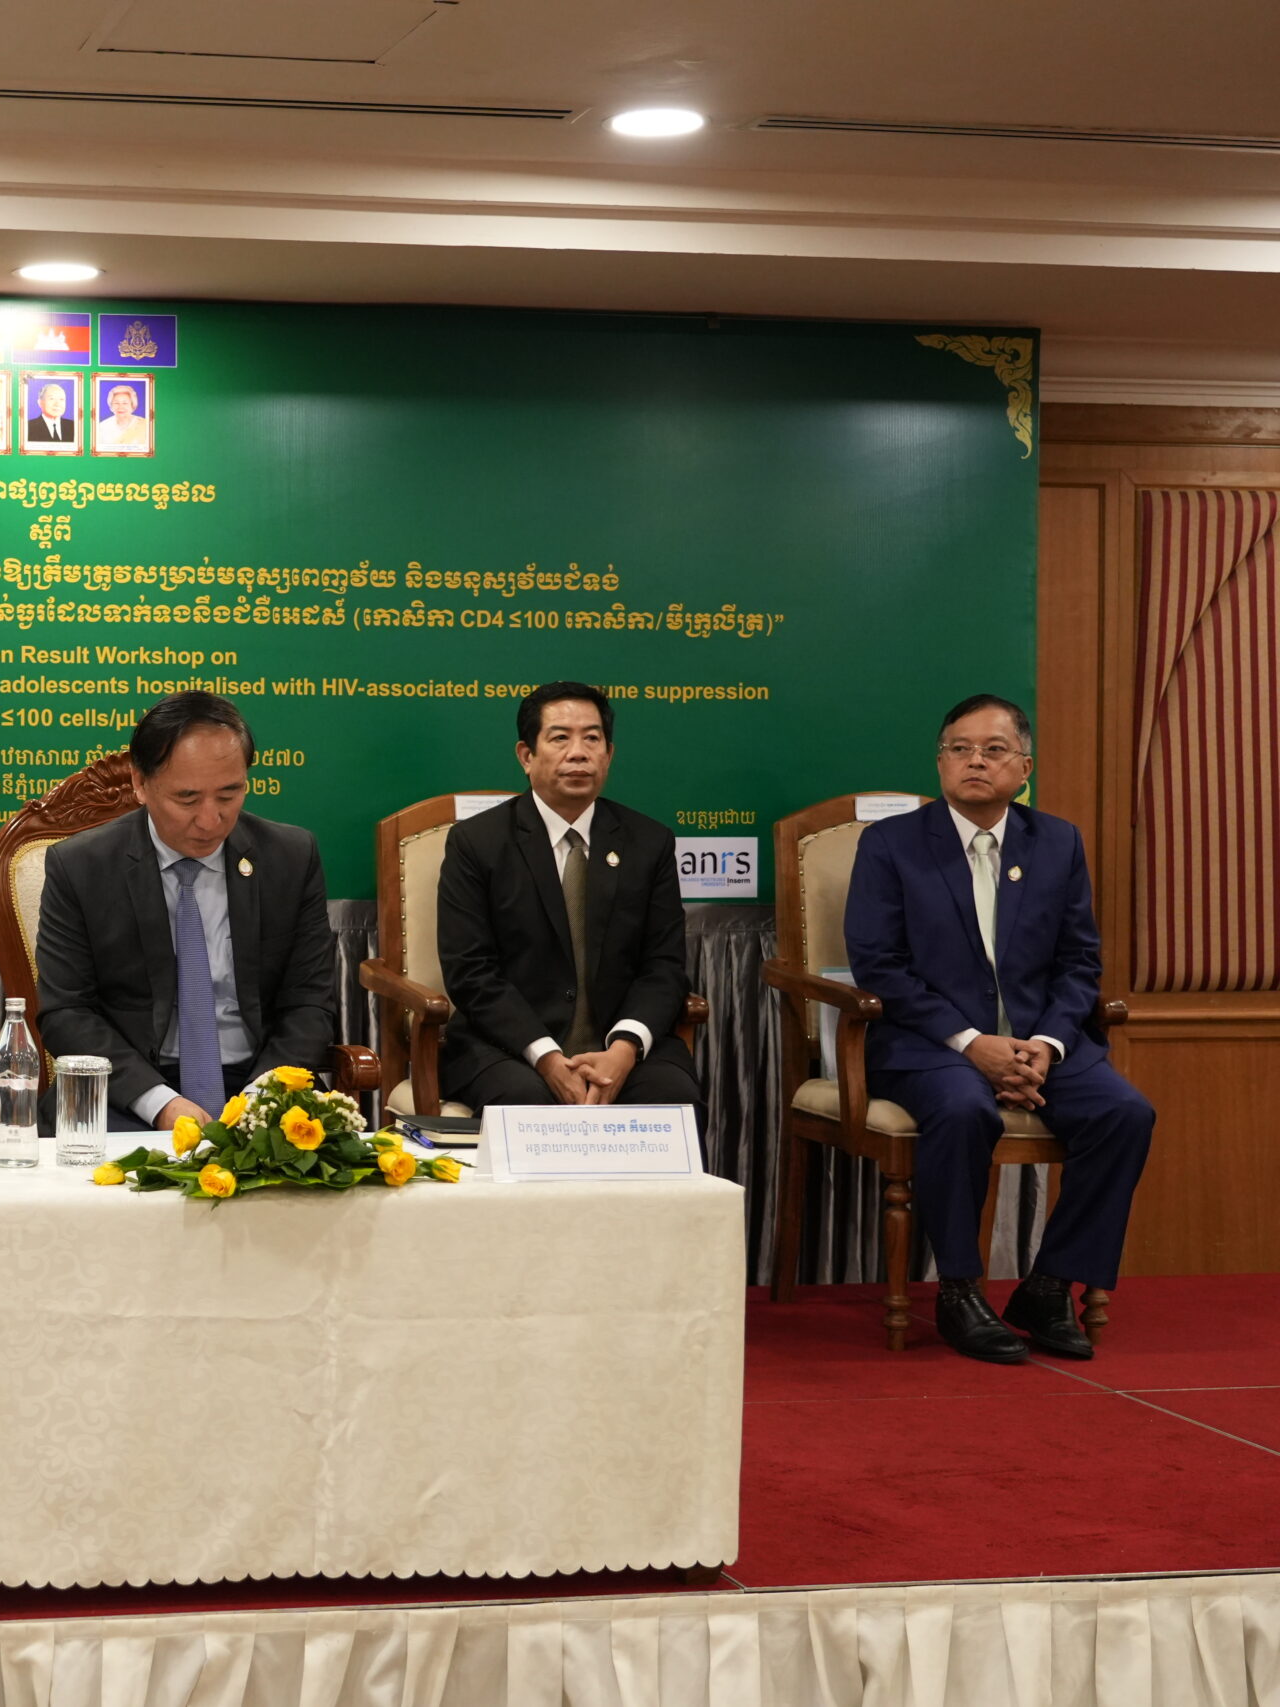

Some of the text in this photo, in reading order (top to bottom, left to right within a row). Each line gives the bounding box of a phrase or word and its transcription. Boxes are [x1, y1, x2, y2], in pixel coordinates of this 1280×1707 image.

[461, 610, 505, 628] CD4
[510, 610, 561, 628] ≤100
[20, 645, 90, 665] Result
[95, 645, 205, 669] Workshop
[210, 651, 237, 665] on
[0, 675, 130, 695] adolescents
[136, 676, 266, 699] hospitalised
[271, 677, 316, 696] with
[322, 678, 479, 698] HIV-associated
[644, 684, 769, 703] suppression
[1, 708, 54, 727] ≤100
[680, 851, 751, 875] anrs
